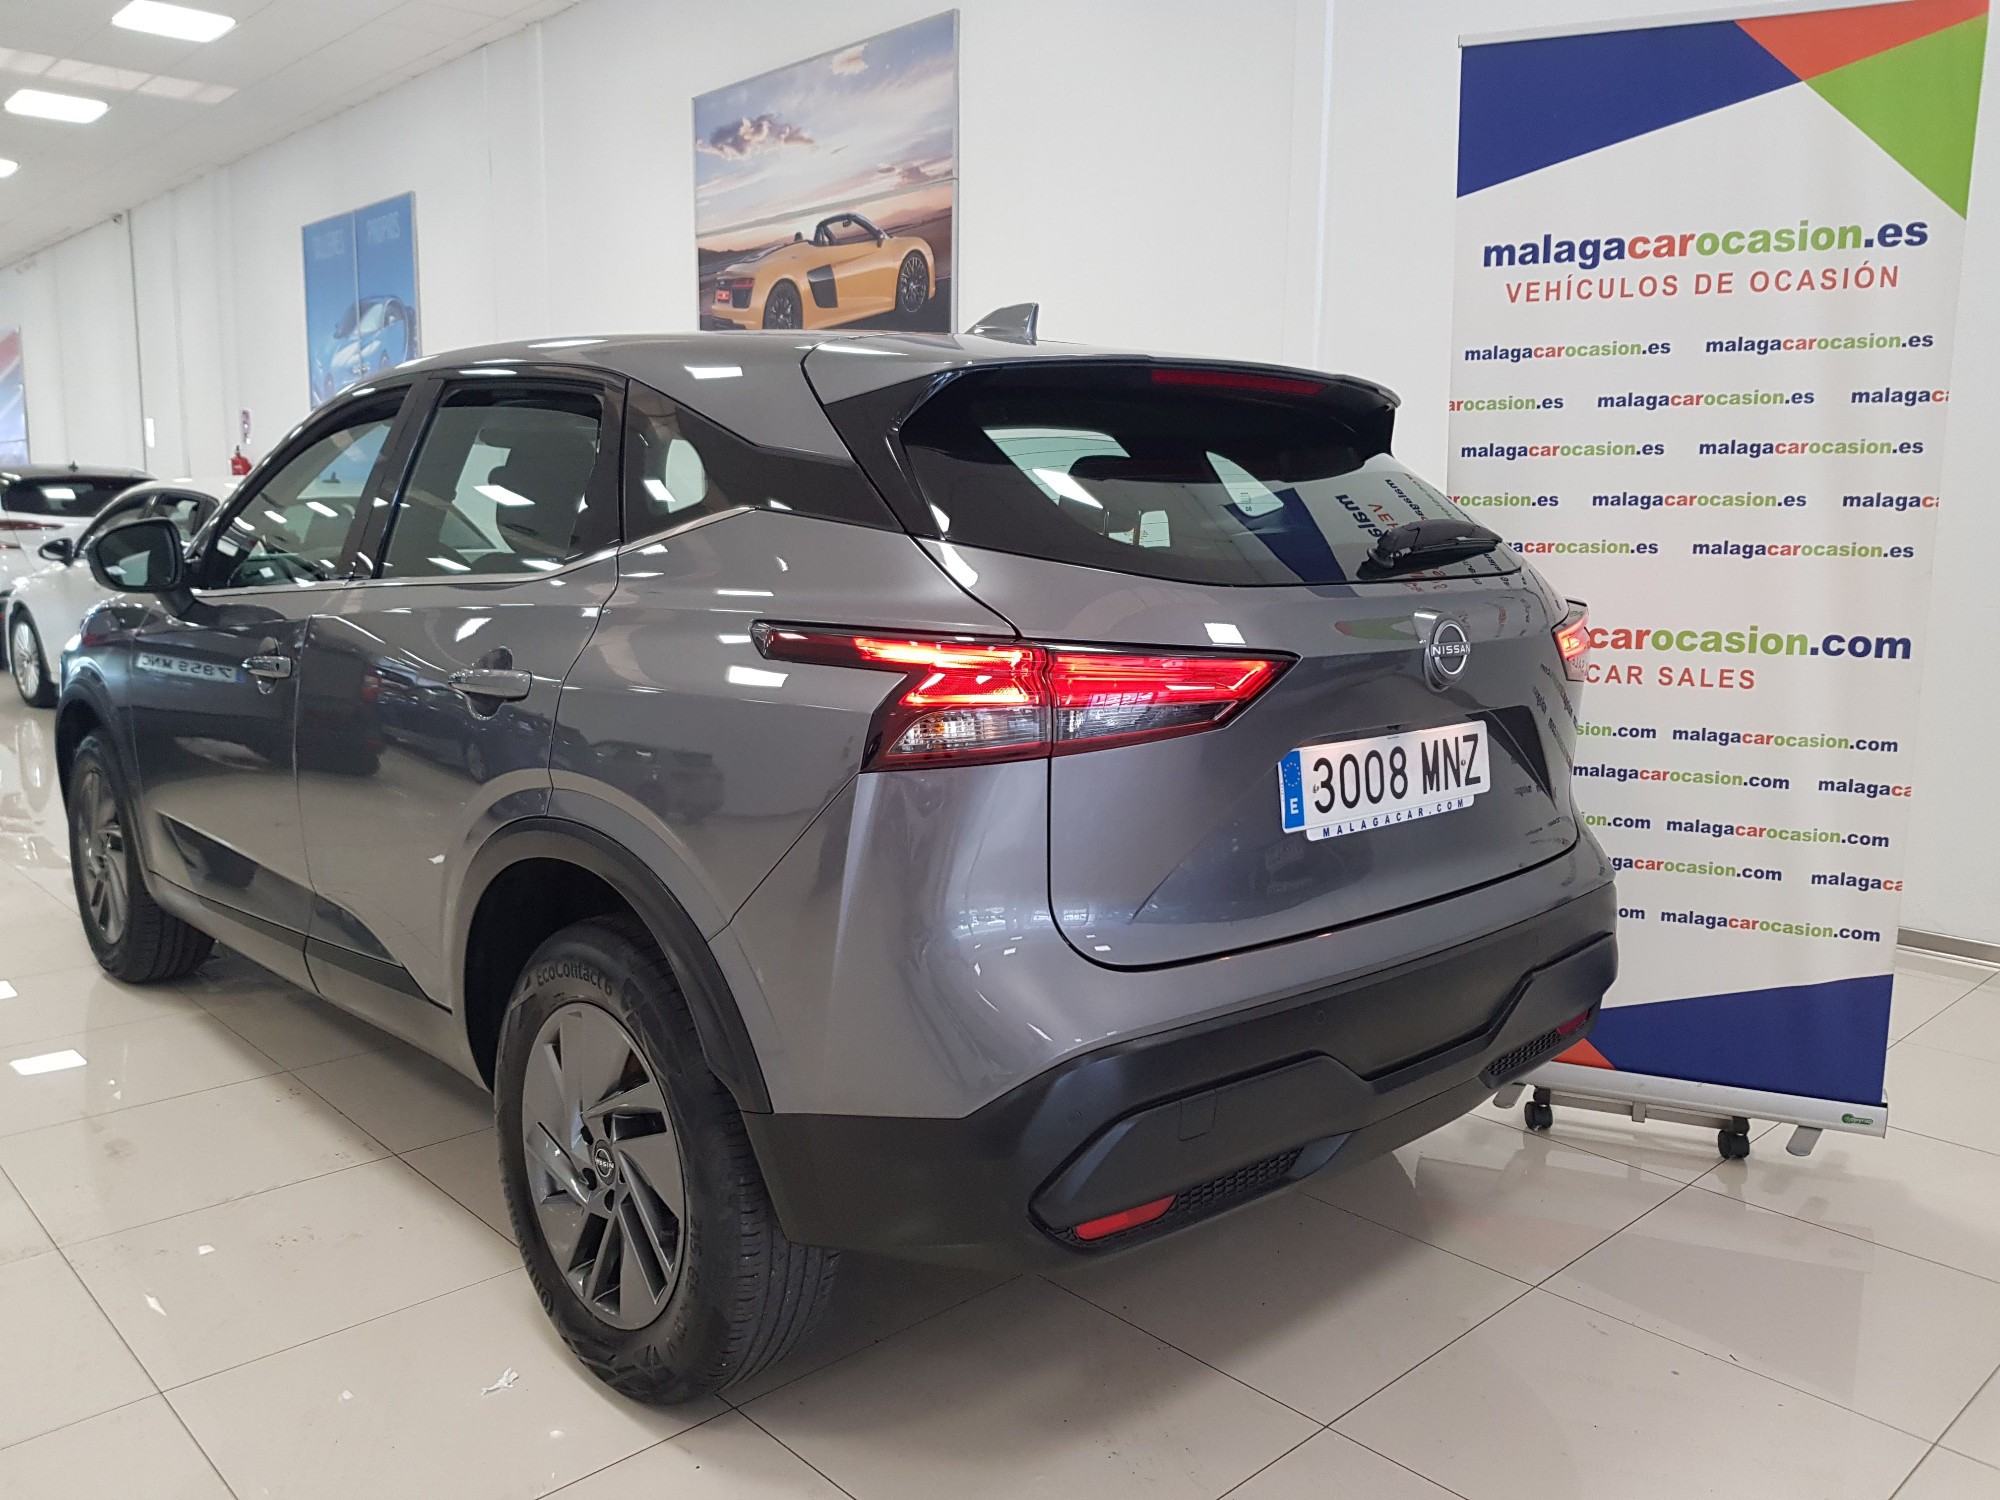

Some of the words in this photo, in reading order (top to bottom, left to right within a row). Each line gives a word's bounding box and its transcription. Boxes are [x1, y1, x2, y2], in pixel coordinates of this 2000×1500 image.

[1482, 219, 1928, 271] malagacarocasion.es
[1506, 274, 1678, 304] VEHÍCULOS
[1695, 272, 1733, 295] DE
[1750, 260, 1898, 293] OCASIÓN
[1464, 339, 1671, 363] malagacarocasion.es
[1705, 331, 1934, 355] malagacarocasion.es
[1597, 389, 1815, 411] malagacarocasion.es
[1461, 441, 1665, 461] malagacarocasion.es
[1699, 436, 1924, 459] malagacarocasion.es
[1592, 490, 1807, 511] malagacarocasion.es
[1507, 537, 1659, 555] acarocasion.es
[1692, 538, 1914, 560] malagacarocasion.es
[1431, 643, 1471, 656] NISSAN
[1585, 663, 1643, 685] CAR
[1657, 665, 1755, 690] SALES
[1672, 726, 1898, 753] malagacarocasion.com
[1312, 745, 1409, 814] 3008
[1420, 733, 1482, 795] MNZ
[1573, 762, 1790, 790] malagacarocasion.com
[1290, 797, 1299, 815] E
[1666, 818, 1889, 848] malagacarocasion.com
[1609, 856, 1782, 882] gacarocasion.com
[1660, 908, 1881, 942] malagacarocasion.com
